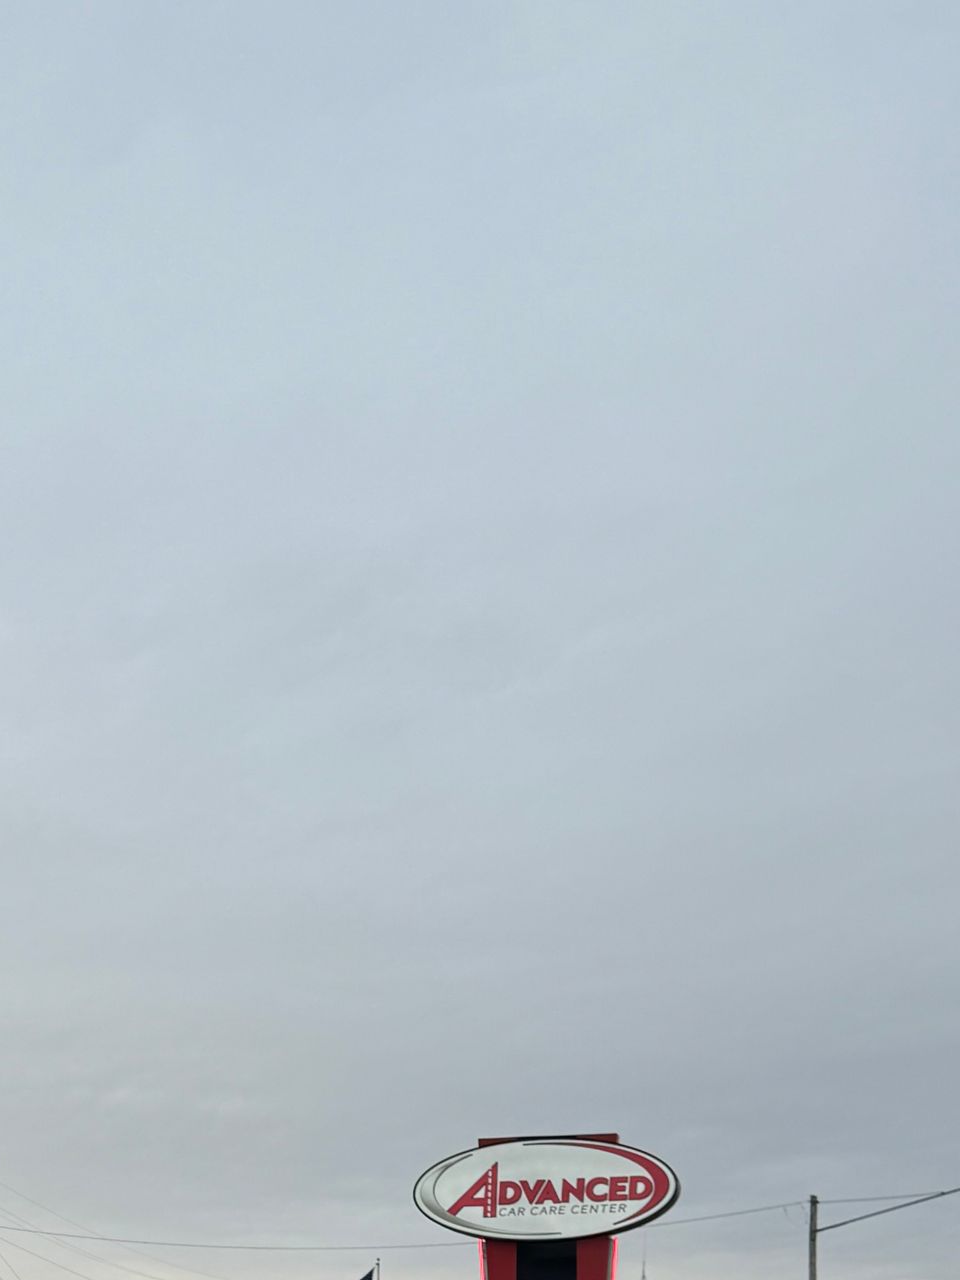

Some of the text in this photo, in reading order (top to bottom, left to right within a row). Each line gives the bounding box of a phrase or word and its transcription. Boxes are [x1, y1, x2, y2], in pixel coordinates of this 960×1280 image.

[446, 1161, 653, 1218] ADVANCED
[499, 1204, 627, 1217] CAR CARE CENTER
